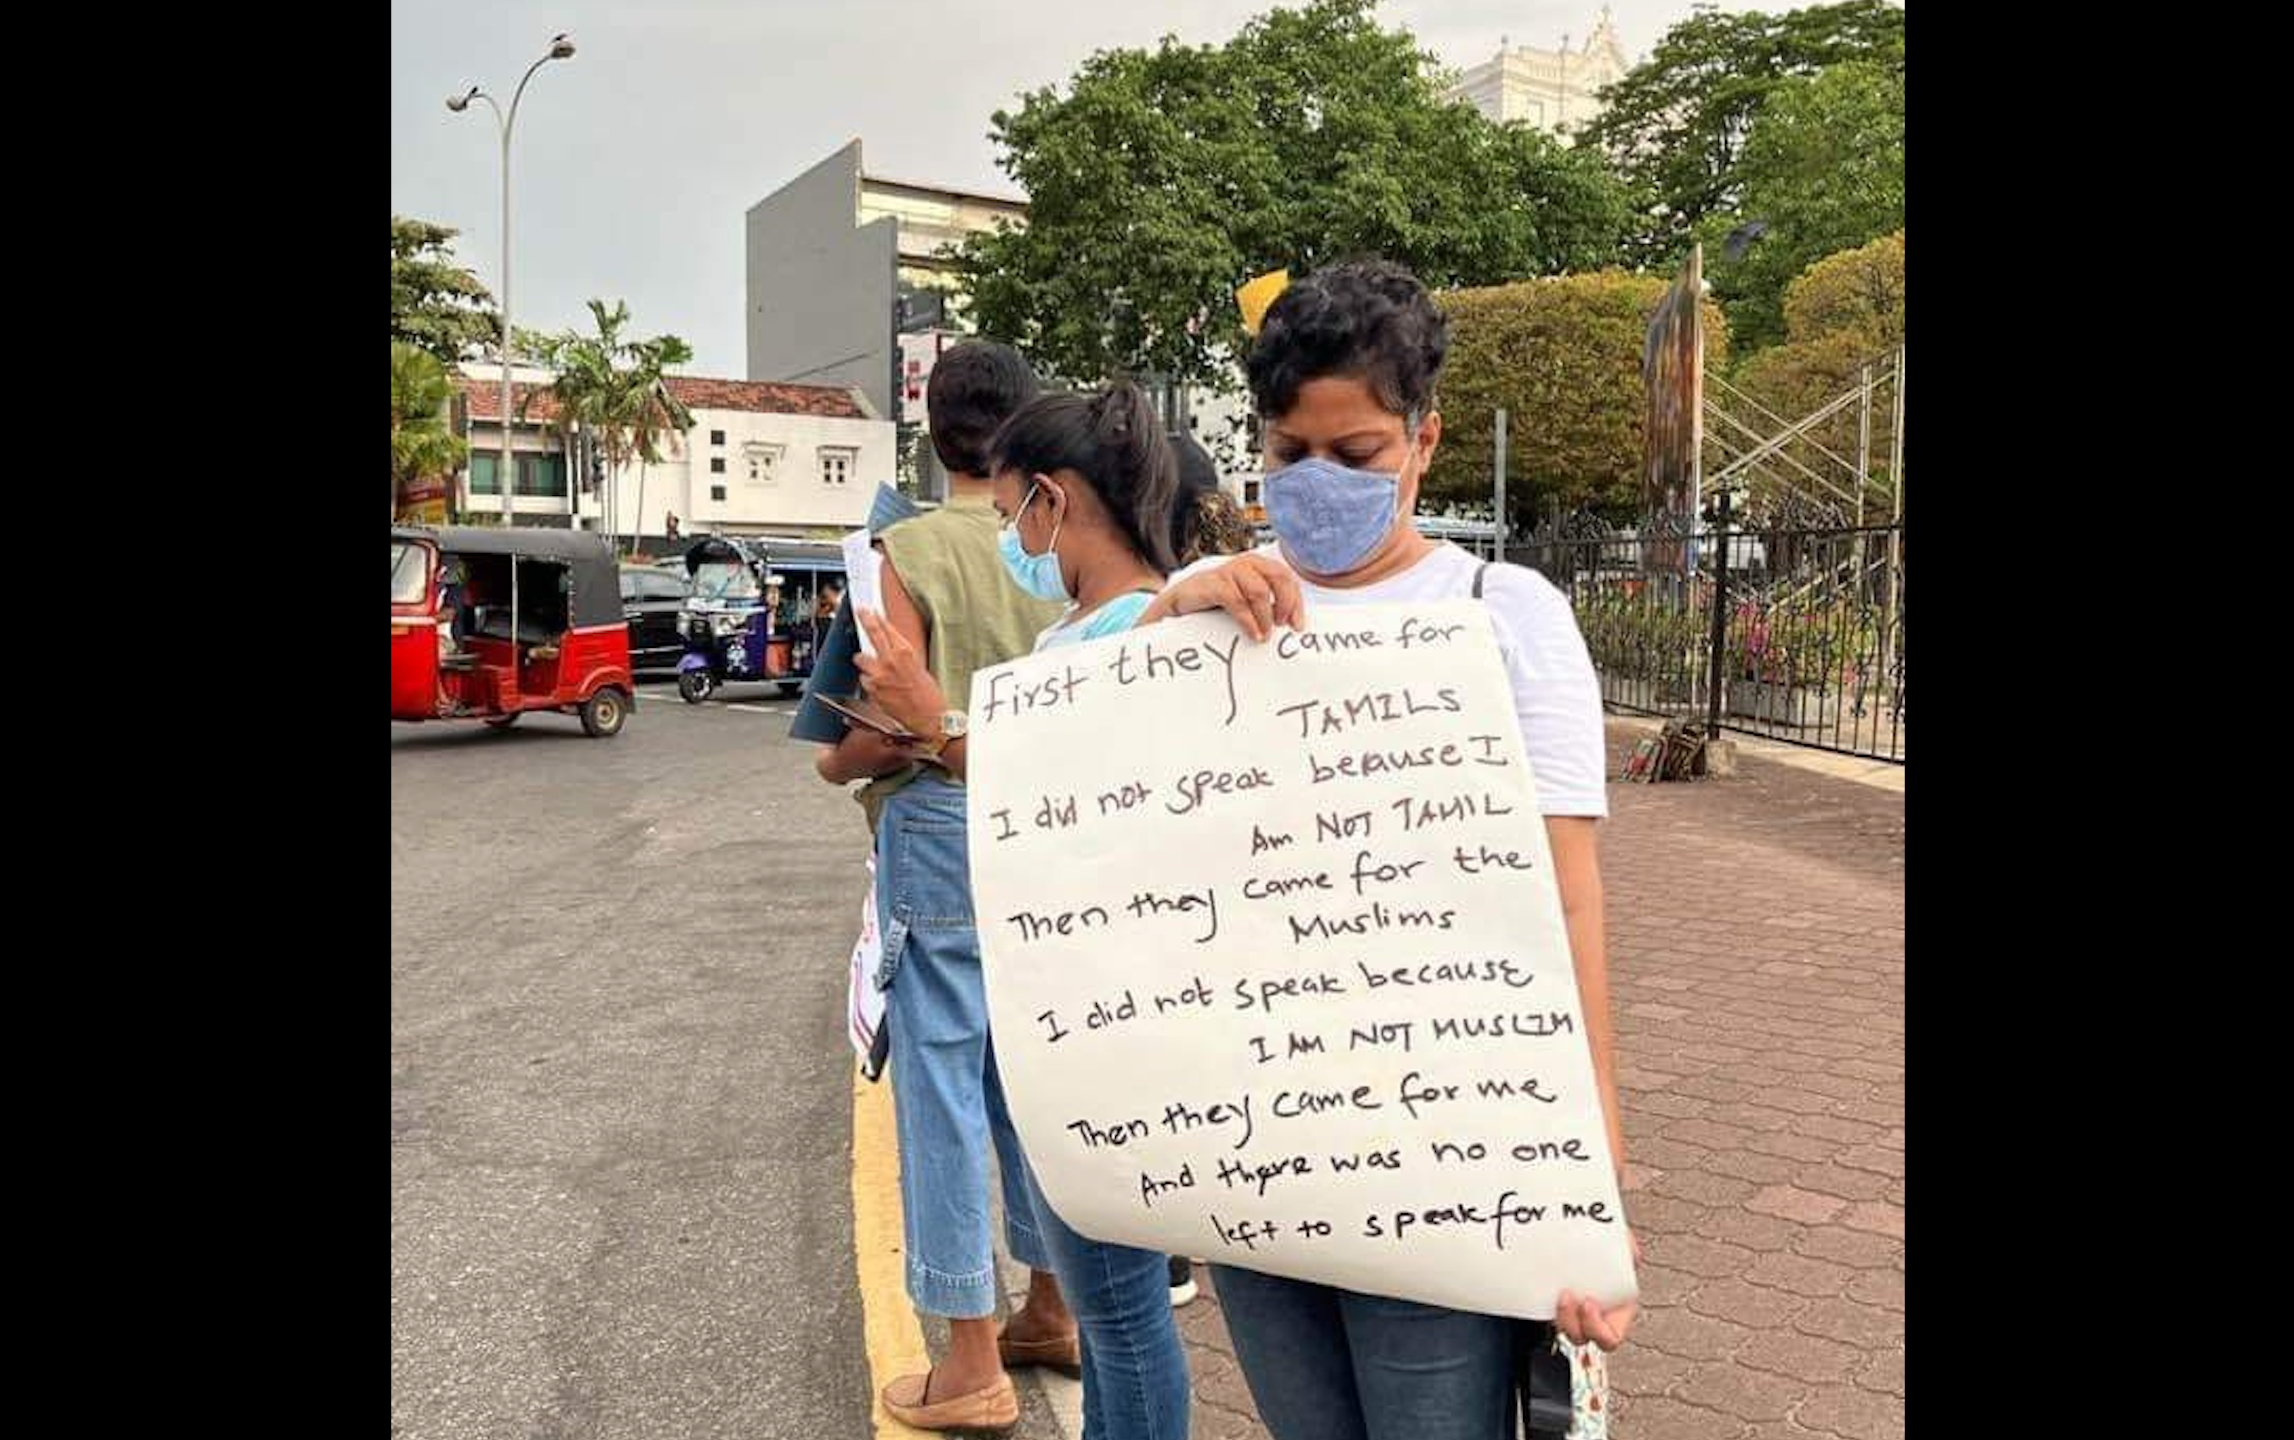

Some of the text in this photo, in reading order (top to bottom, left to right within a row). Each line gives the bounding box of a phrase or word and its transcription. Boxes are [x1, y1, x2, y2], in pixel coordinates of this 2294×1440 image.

[1108, 634, 1240, 726] they
[1276, 626, 1383, 661] came
[1393, 617, 1466, 650] for
[1276, 688, 1462, 739] TAMILS
[989, 808, 1020, 842] I
[1034, 794, 1078, 830] did
[1097, 781, 1153, 816] not
[1467, 734, 1509, 766] I
[1315, 810, 1373, 843] NOT
[1391, 793, 1513, 832] TAMIL
[1006, 845, 1533, 944] Then they came for the
[1288, 901, 1456, 945] Muslims
[1036, 1009, 1070, 1044] I
[1086, 989, 1137, 1030] did
[1153, 976, 1214, 1013] not
[1248, 1035, 1277, 1065] I
[1349, 1021, 1414, 1053] NOT
[1432, 1011, 1574, 1041] MUSLIM
[1066, 1071, 1559, 1151] Then they came for me
[1140, 1163, 1196, 1208] And
[1329, 1148, 1402, 1174] was
[1430, 1141, 1487, 1163] no
[1510, 1138, 1591, 1163] one
[1210, 1213, 1279, 1251] left
[1296, 1220, 1333, 1239] to
[1489, 1190, 1544, 1250] for
[1561, 1201, 1614, 1224] me
